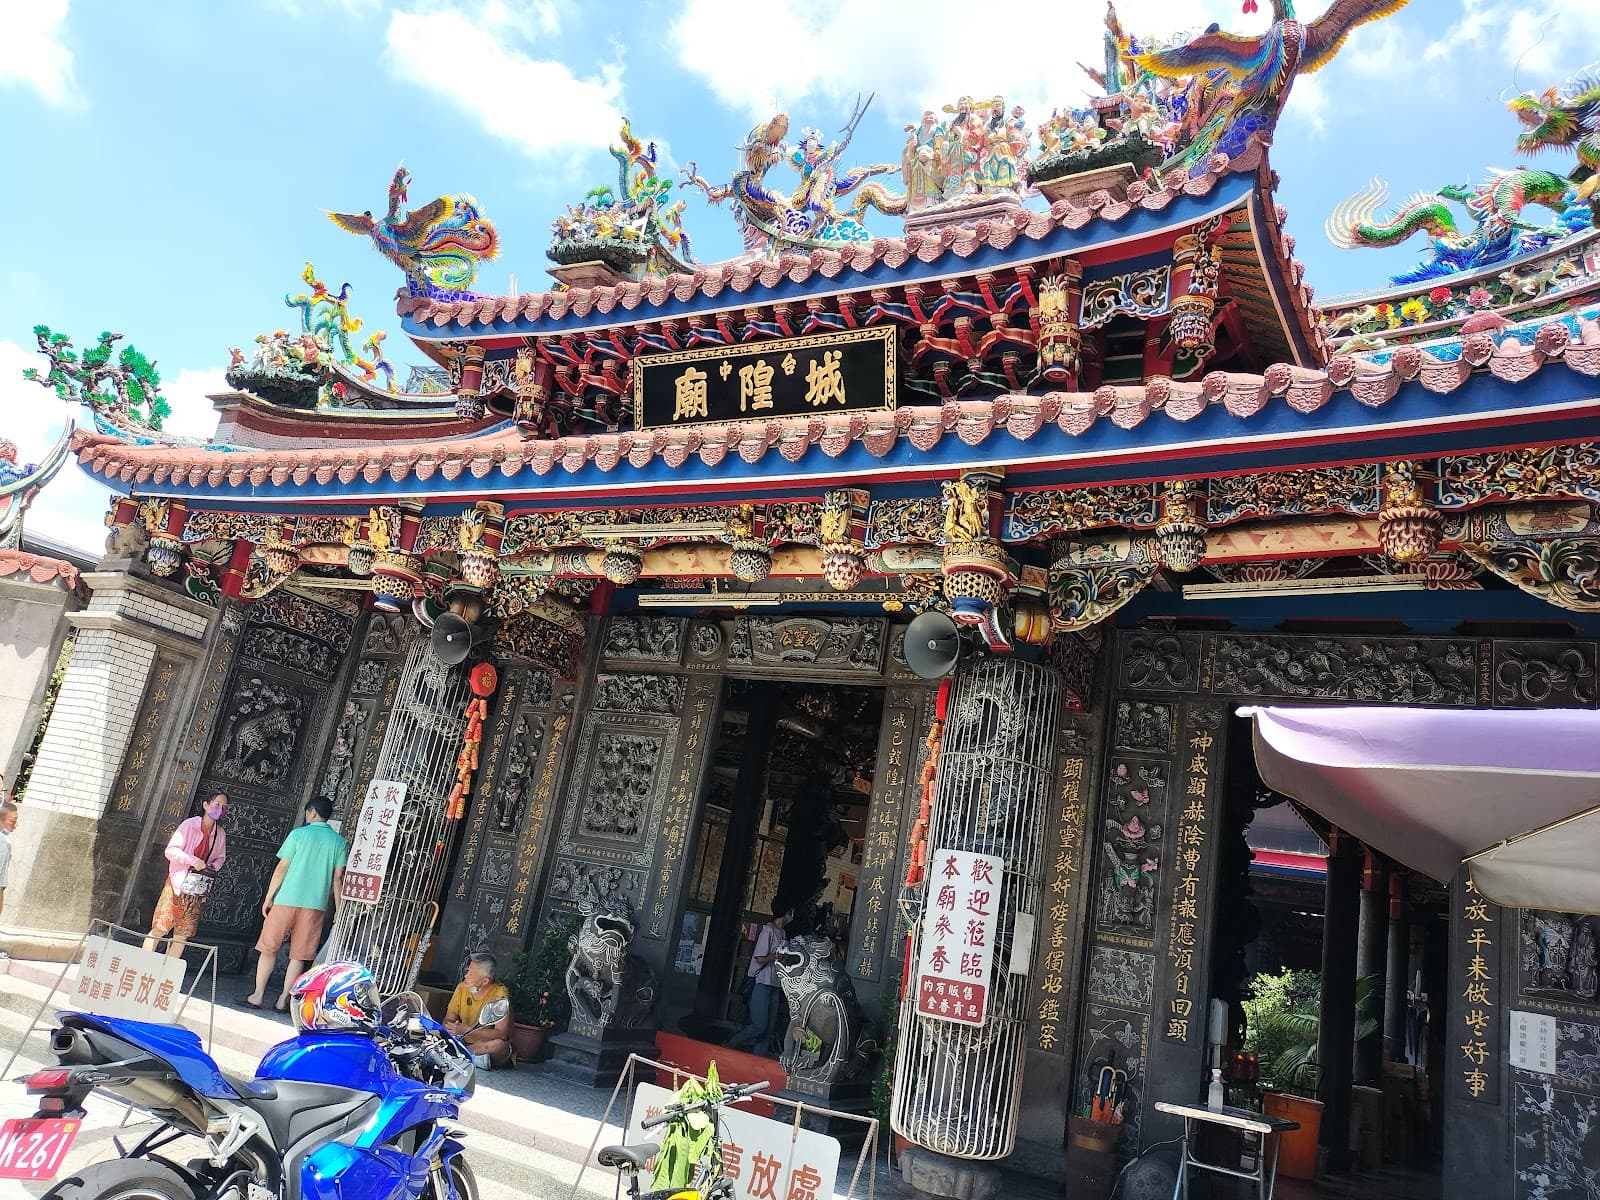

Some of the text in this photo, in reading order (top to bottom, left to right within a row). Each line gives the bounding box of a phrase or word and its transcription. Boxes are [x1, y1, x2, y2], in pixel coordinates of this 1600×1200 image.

[928, 855, 960, 974] 本廟參香
[960, 858, 994, 979] 歡迎蒞臨
[117, 966, 174, 1012] 停放處
[926, 996, 978, 1018] 金香貢品
